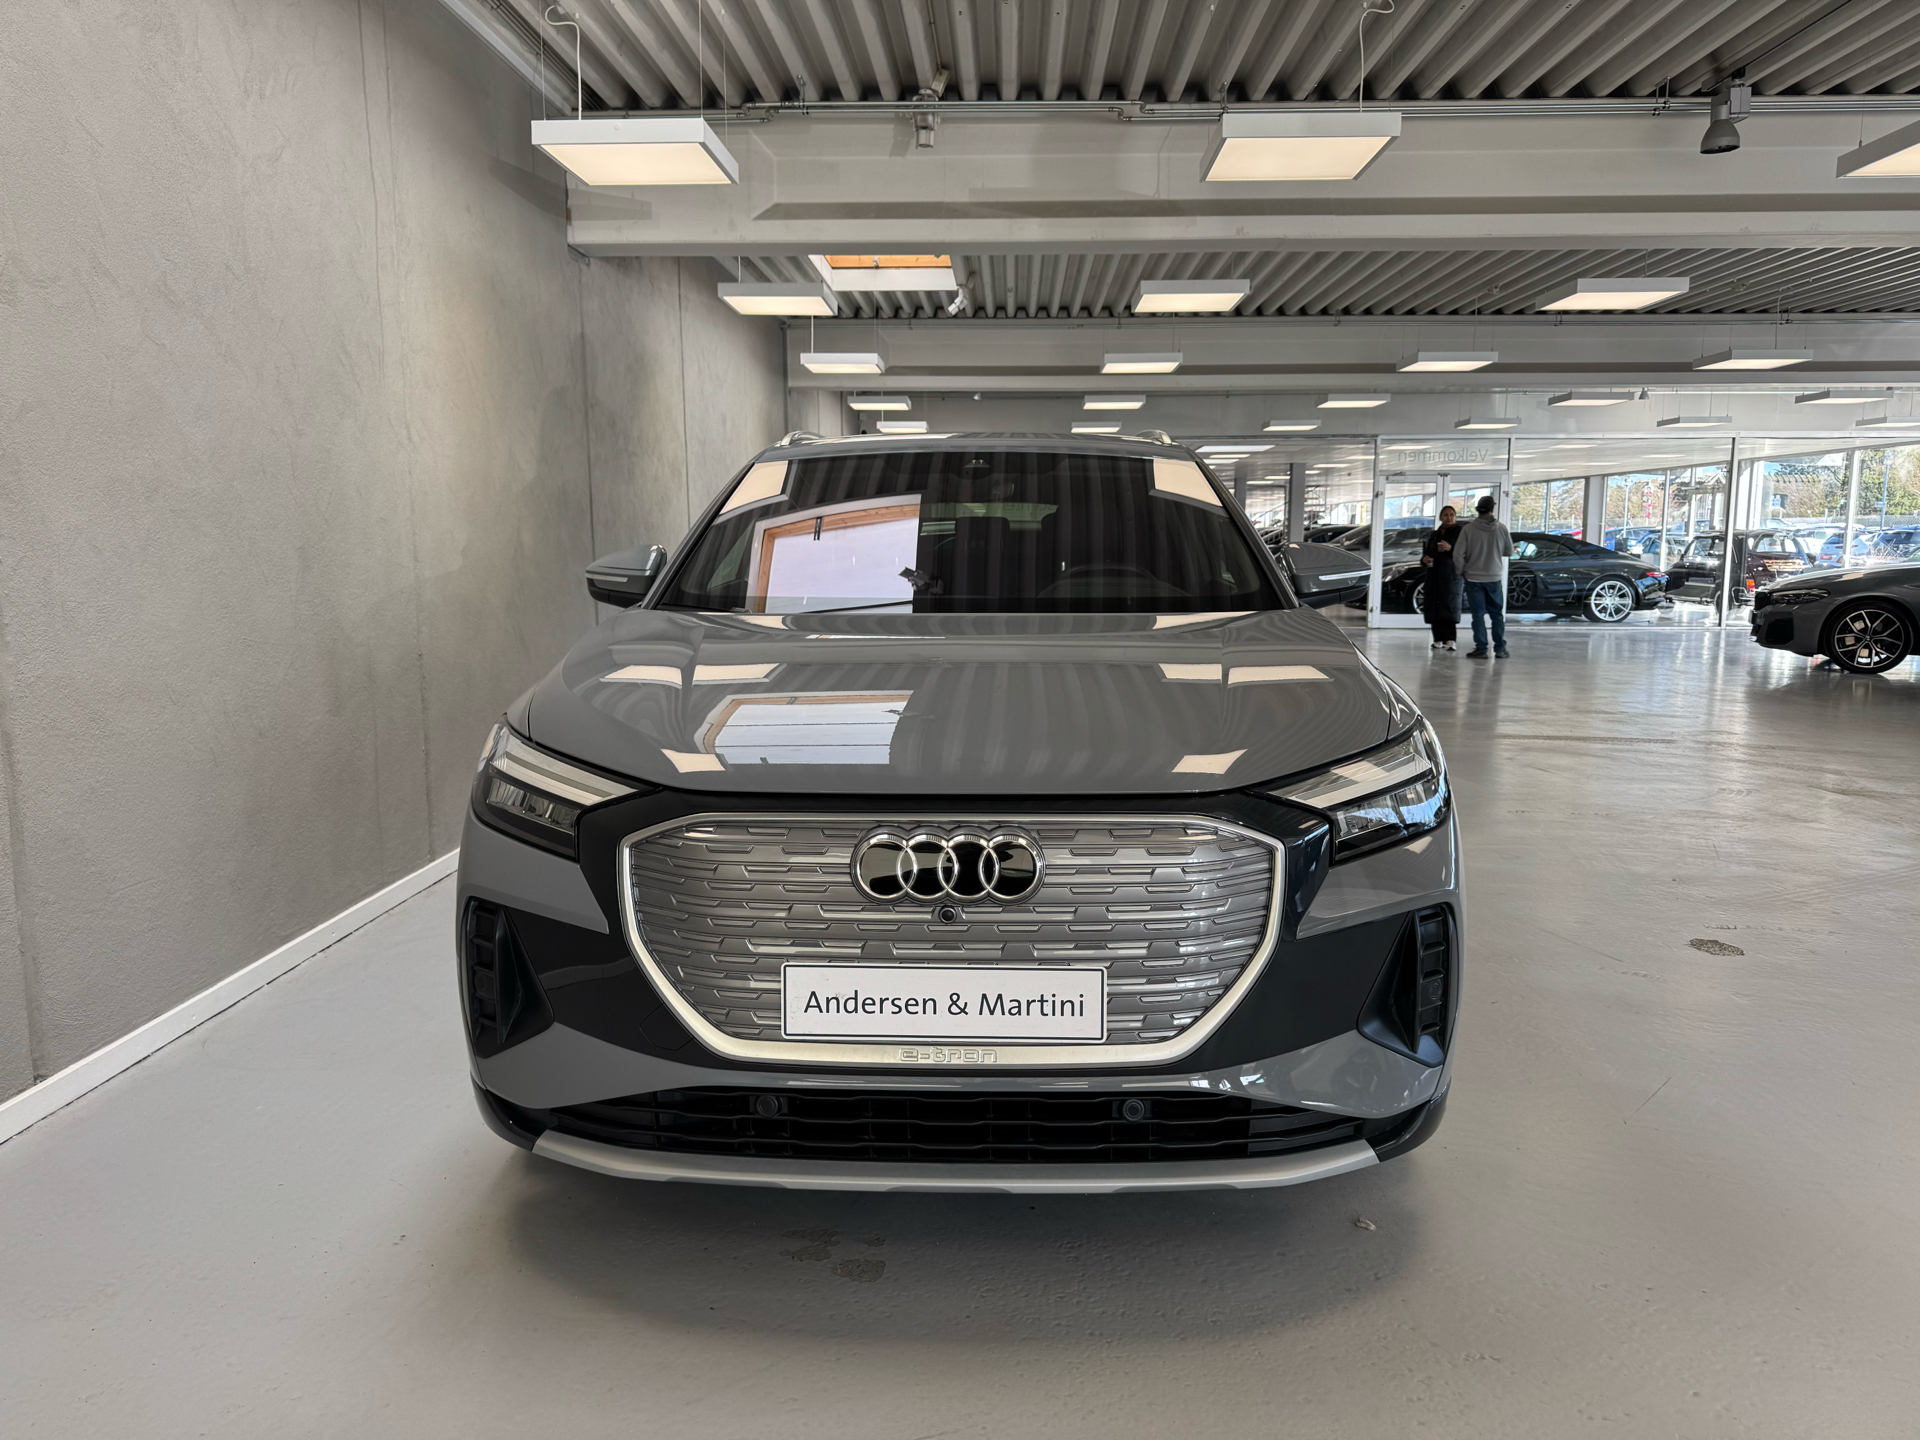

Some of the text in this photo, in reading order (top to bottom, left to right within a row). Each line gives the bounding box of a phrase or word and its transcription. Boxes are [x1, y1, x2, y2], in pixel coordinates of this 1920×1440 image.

[803, 989, 1084, 1017] Andersen & Martini
[900, 1046, 998, 1063] e-tron
